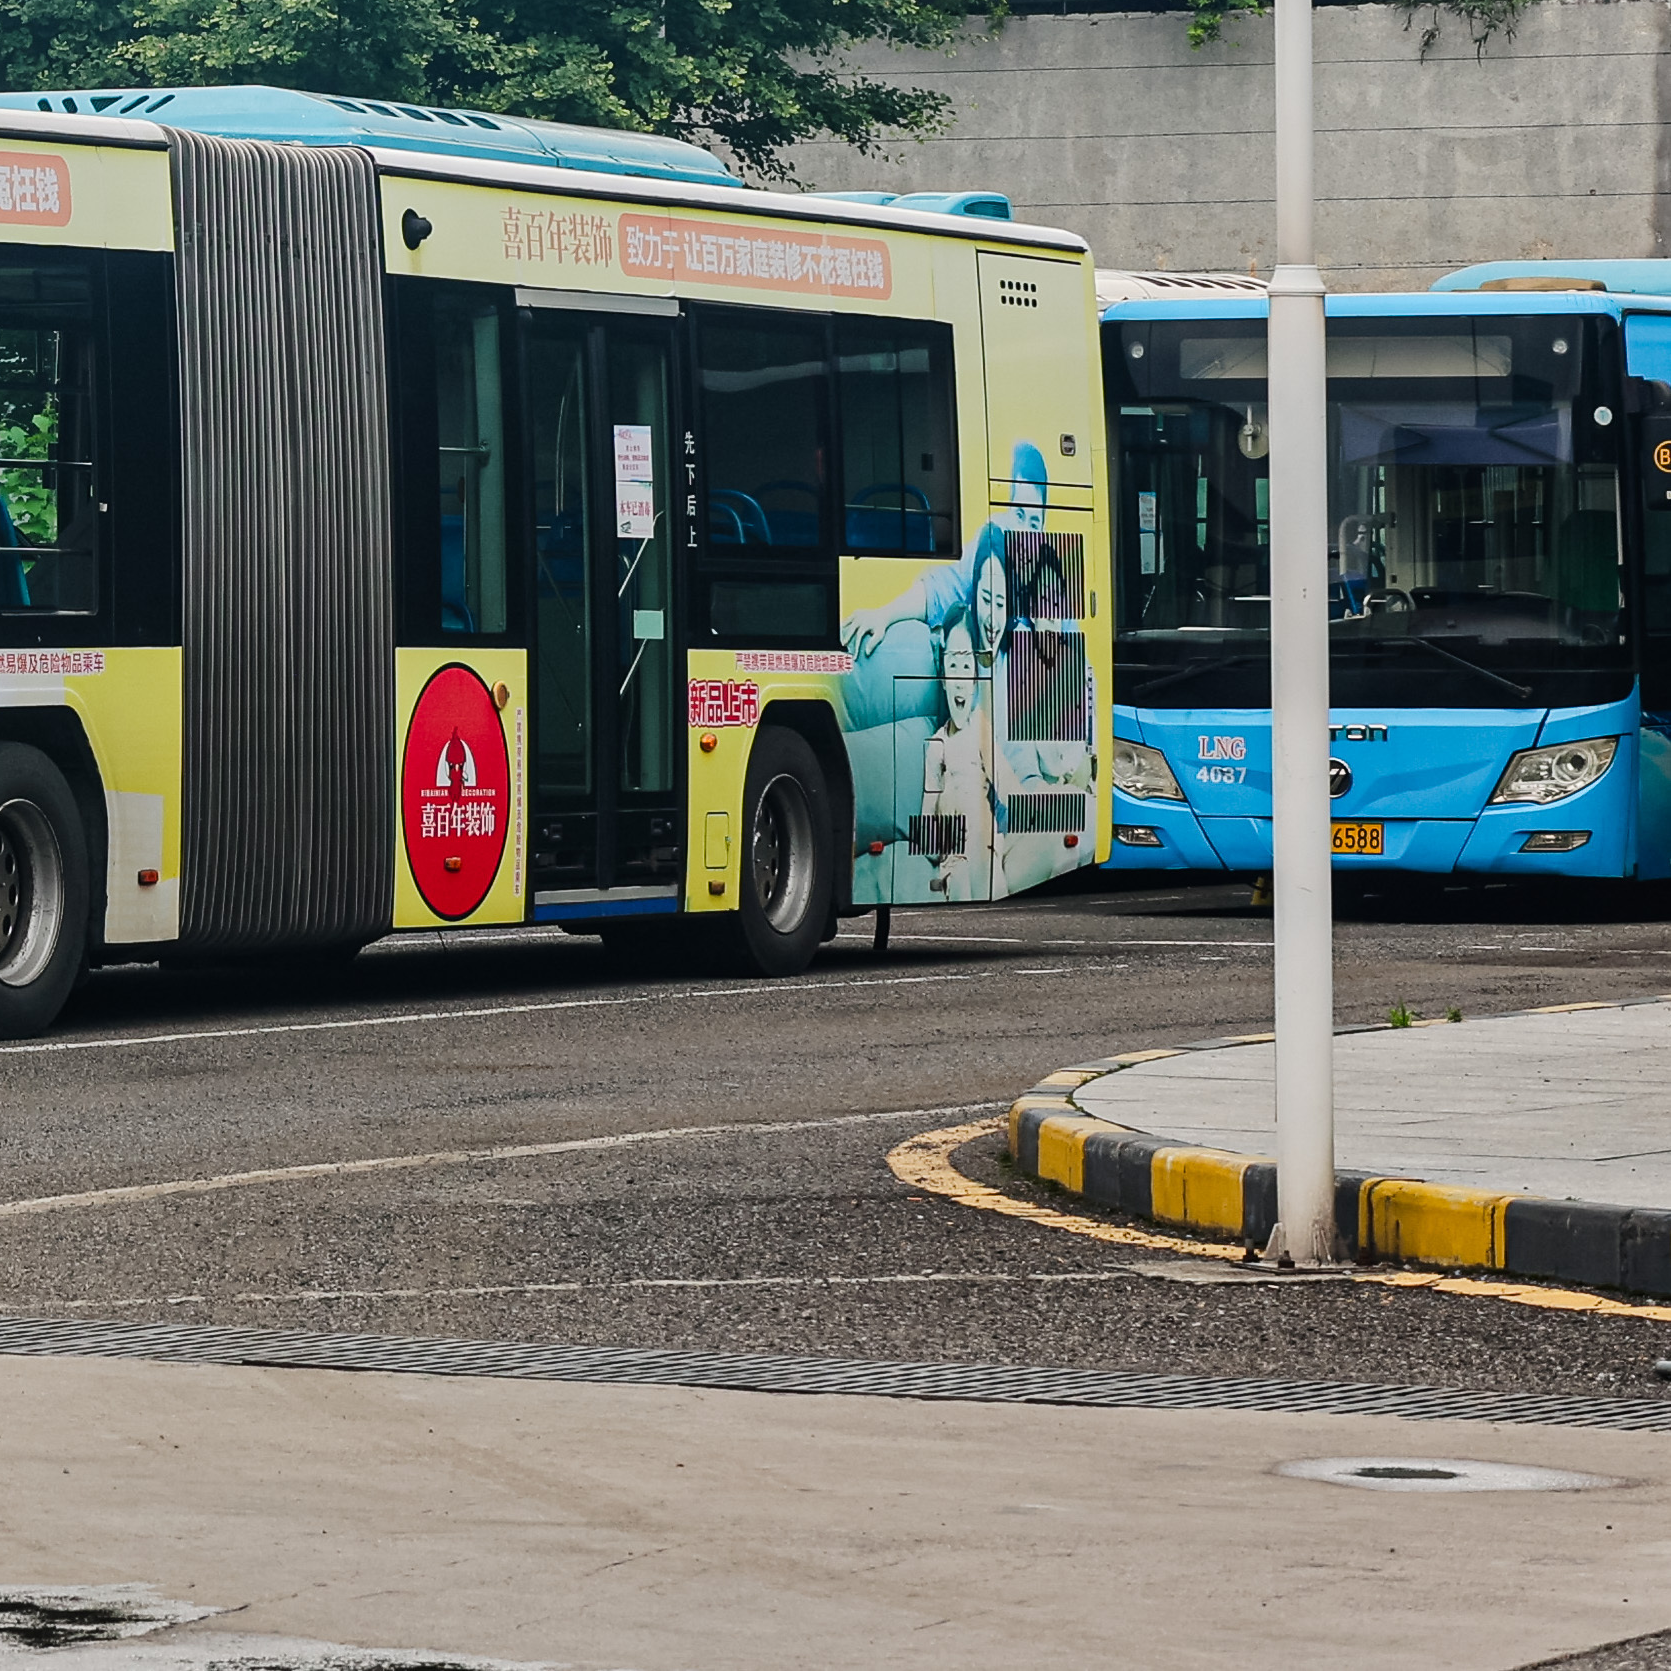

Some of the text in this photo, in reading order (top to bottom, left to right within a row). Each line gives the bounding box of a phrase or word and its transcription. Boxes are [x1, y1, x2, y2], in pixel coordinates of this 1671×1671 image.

[499, 205, 613, 268] 喜百年装饰
[625, 225, 884, 289] 致力于 让百万家庭装修不花冤枉钱
[1660, 448, 1671, 465] B
[684, 431, 698, 548] 先下后上
[689, 680, 759, 727] 新品上市
[1197, 736, 1247, 760] LNG
[420, 801, 496, 838] 喜百年装饰
[1333, 827, 1381, 850] 6588
